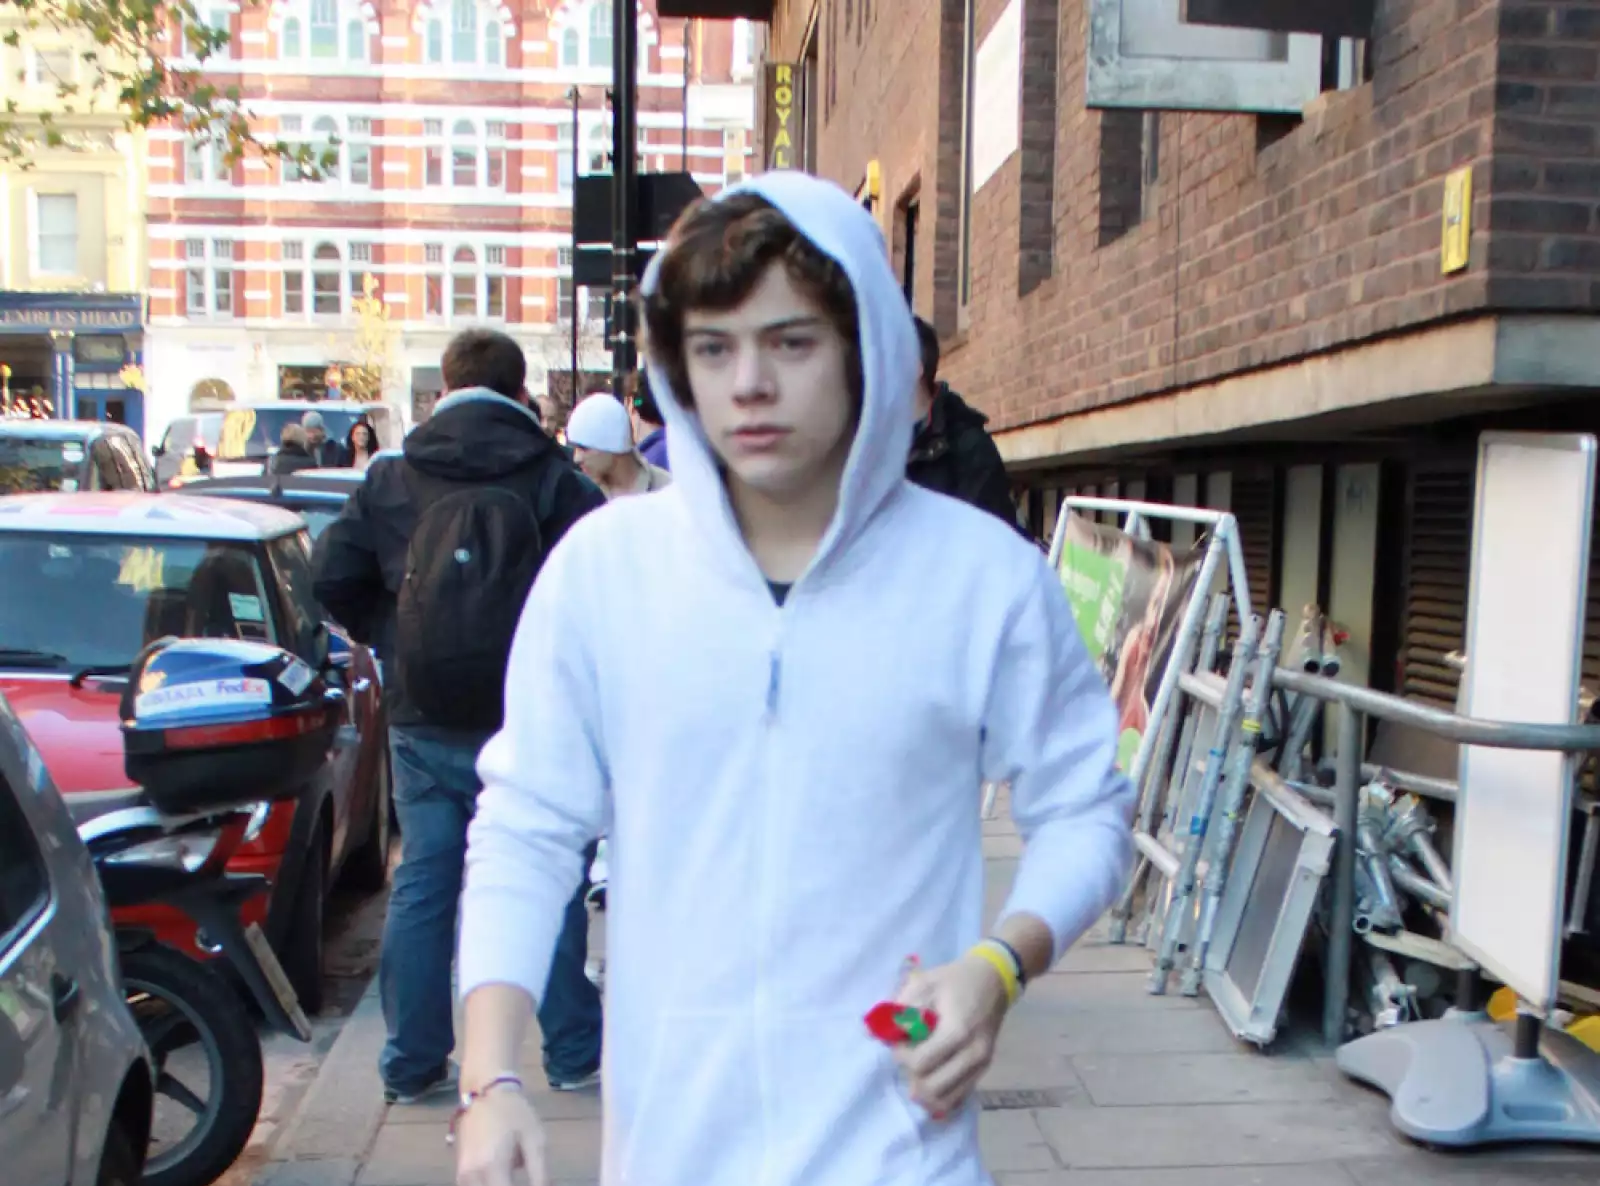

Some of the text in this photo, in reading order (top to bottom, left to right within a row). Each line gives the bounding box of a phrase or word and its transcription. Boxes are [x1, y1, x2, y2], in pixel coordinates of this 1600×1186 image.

[776, 65, 792, 168] ROYAL
[0, 310, 135, 325] EMBLES HEAD
[216, 679, 264, 694] FedEx
